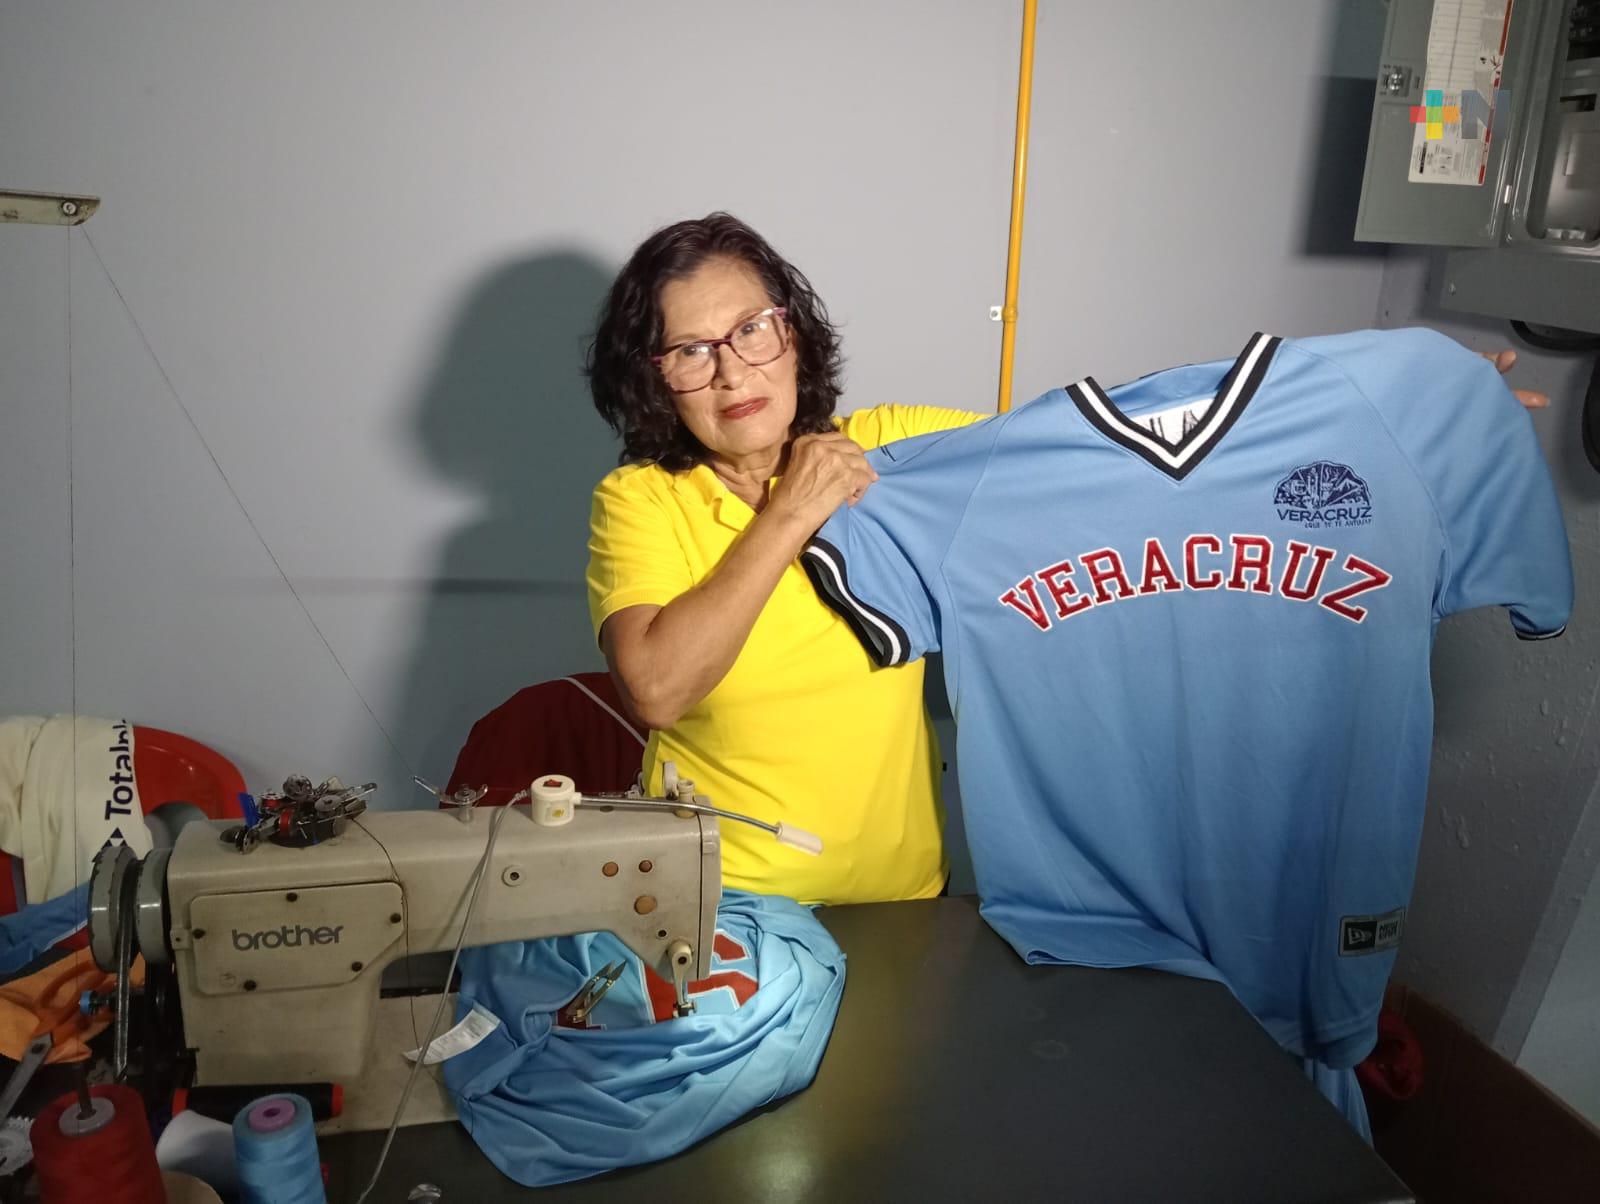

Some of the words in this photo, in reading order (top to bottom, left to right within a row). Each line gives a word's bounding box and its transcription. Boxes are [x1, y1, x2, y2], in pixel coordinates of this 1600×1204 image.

[1277, 506, 1372, 521] VERACRUZ
[998, 533, 1393, 632] VERACRUZ
[231, 924, 344, 951] brother
